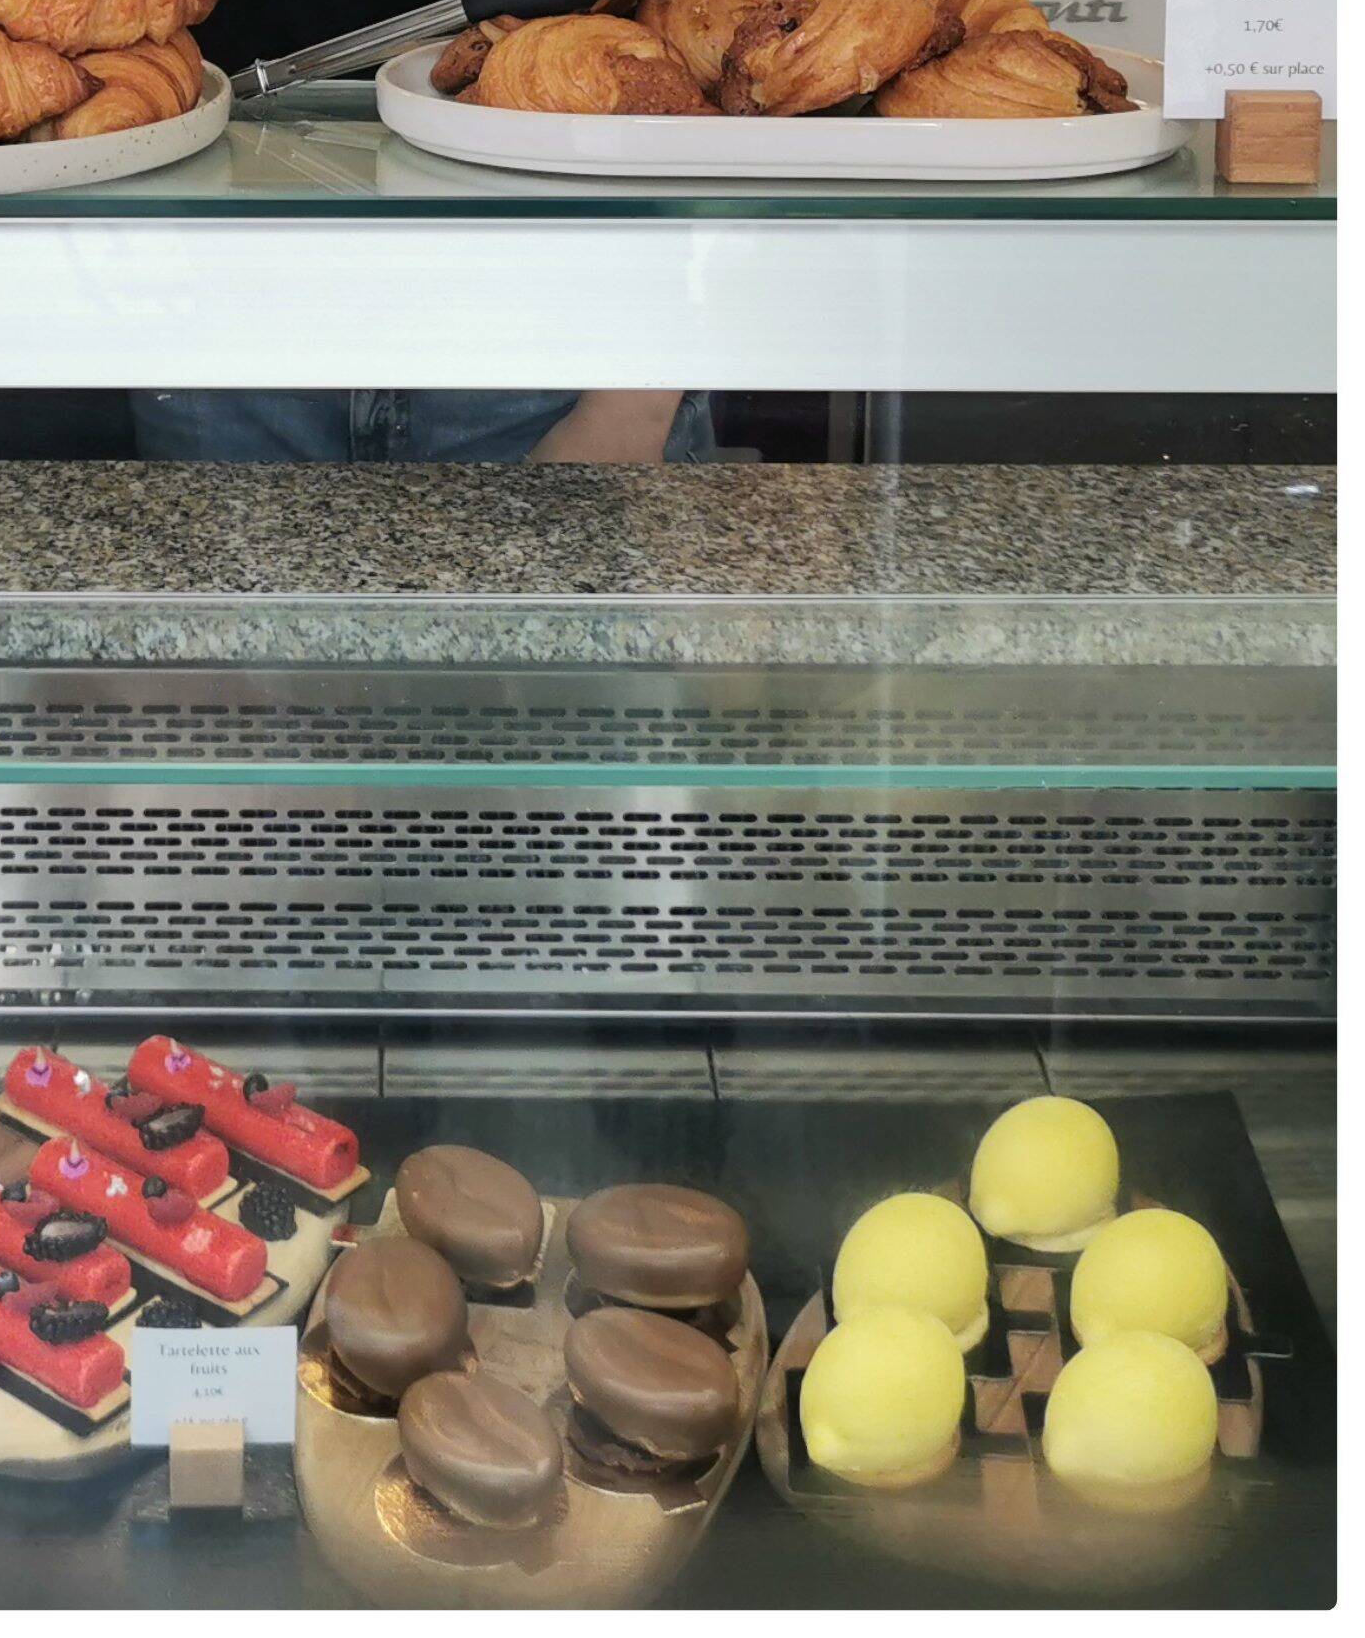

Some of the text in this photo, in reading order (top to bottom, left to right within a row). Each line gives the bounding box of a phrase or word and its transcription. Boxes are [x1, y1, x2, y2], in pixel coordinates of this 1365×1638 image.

[1243, 18, 1284, 33] 1,70€
[1204, 61, 1325, 78] +0,50 € sur place
[159, 1343, 261, 1357] Tartelette aux
[190, 1362, 228, 1375] fruits
